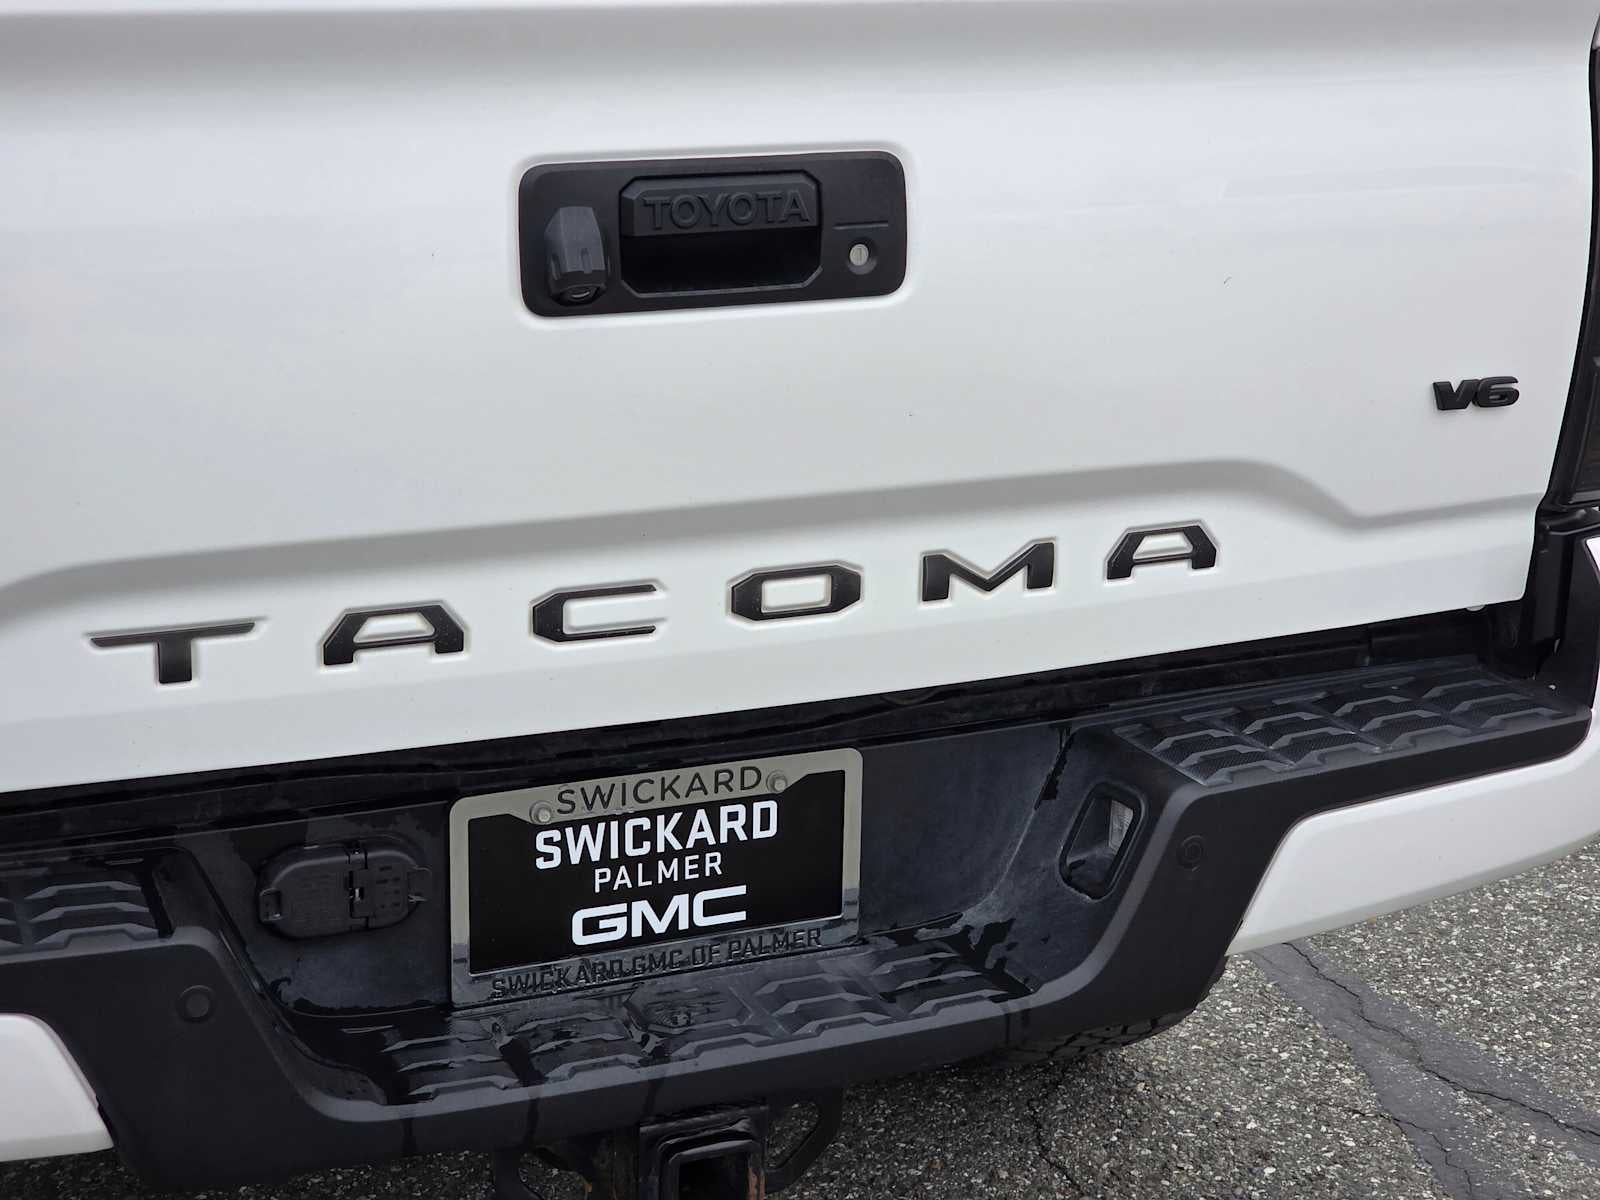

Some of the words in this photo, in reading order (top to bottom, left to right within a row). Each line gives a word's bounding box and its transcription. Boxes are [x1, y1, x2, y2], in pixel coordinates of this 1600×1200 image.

[643, 189, 809, 230] TOYOTA
[1432, 375, 1520, 411] V6
[89, 522, 1219, 685] TACOMA
[556, 766, 763, 815] SWICKARD
[535, 800, 778, 870] SWICKARD
[594, 851, 722, 893] PALMER
[571, 885, 747, 945] GMC
[491, 958, 625, 1000] SWICKARD
[632, 948, 684, 976] GMC
[689, 944, 722, 966] OF
[727, 927, 823, 960] PALMER
